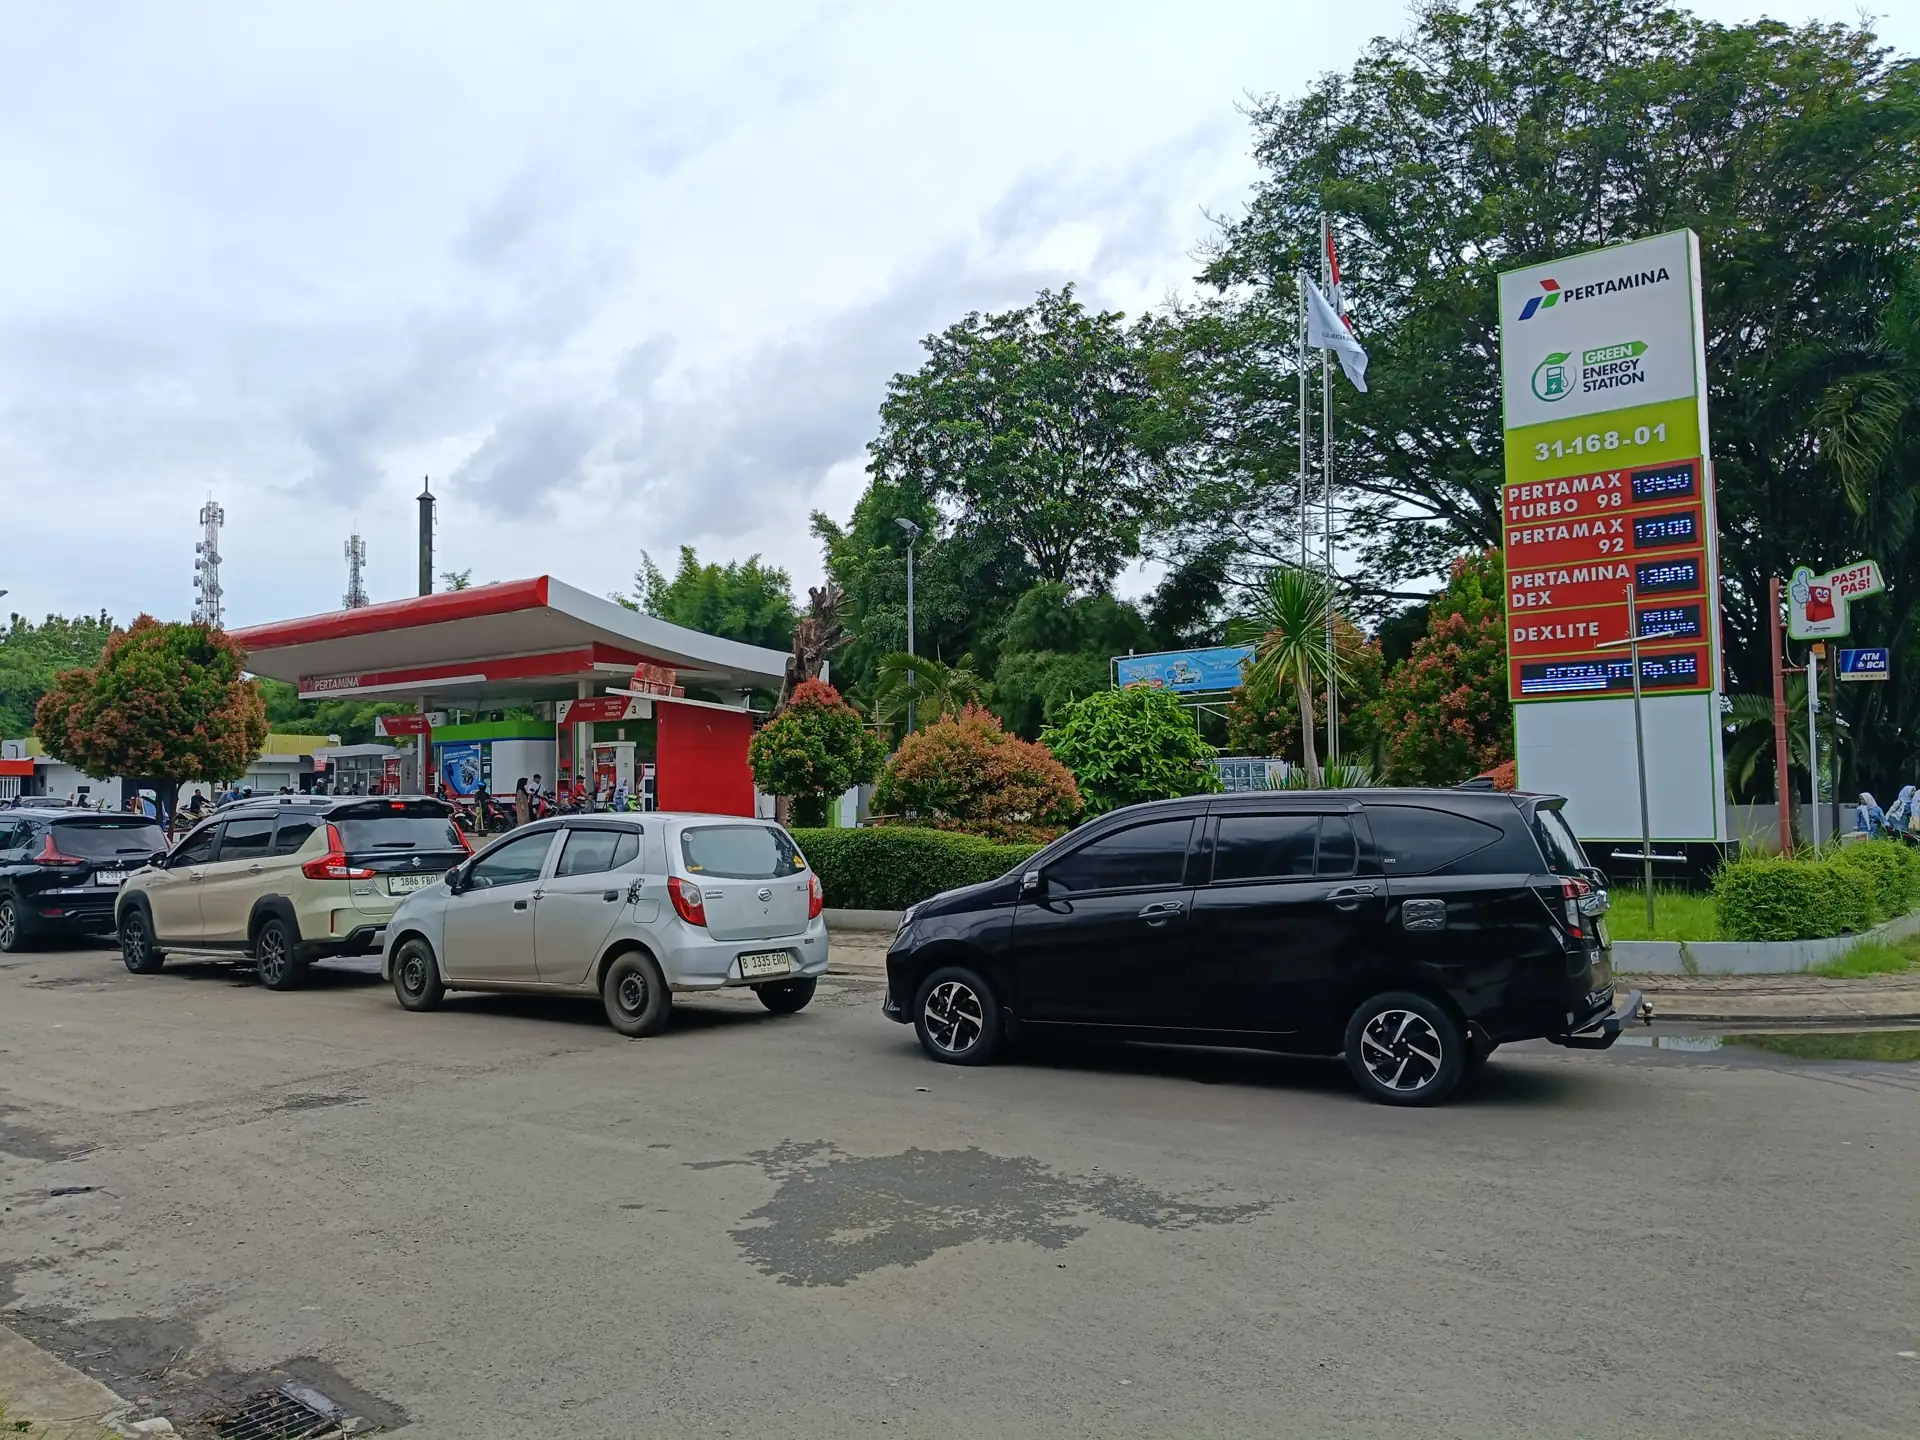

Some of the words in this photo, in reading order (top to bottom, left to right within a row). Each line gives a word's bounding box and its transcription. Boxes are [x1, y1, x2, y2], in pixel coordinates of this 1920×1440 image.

[1564, 267, 1670, 303] PERTAMINA
[1585, 343, 1633, 364] GREEN
[1582, 358, 1641, 380] ENERGY
[1583, 370, 1645, 393] STATION
[1534, 423, 1667, 461] 31-168-01
[1508, 472, 1622, 502] PERTAMAX
[1509, 498, 1578, 521] TURBO
[1597, 492, 1622, 509] 98
[1510, 518, 1624, 546] PERTAMAX
[1635, 519, 1692, 539] 12100
[1598, 537, 1624, 554] 92
[1511, 563, 1630, 589] PERTAMINA
[1831, 566, 1870, 586] PASTI
[1841, 578, 1870, 596] PAS!
[1512, 590, 1552, 608] DEX
[1513, 621, 1599, 643] DEXLITE
[1860, 652, 1880, 661] ATM
[1866, 660, 1885, 668] BCA
[314, 676, 359, 691] PERTAMINA
[631, 705, 637, 714] 3
[400, 876, 419, 887] 1886
[742, 957, 749, 969] B
[751, 955, 771, 968] 1335
